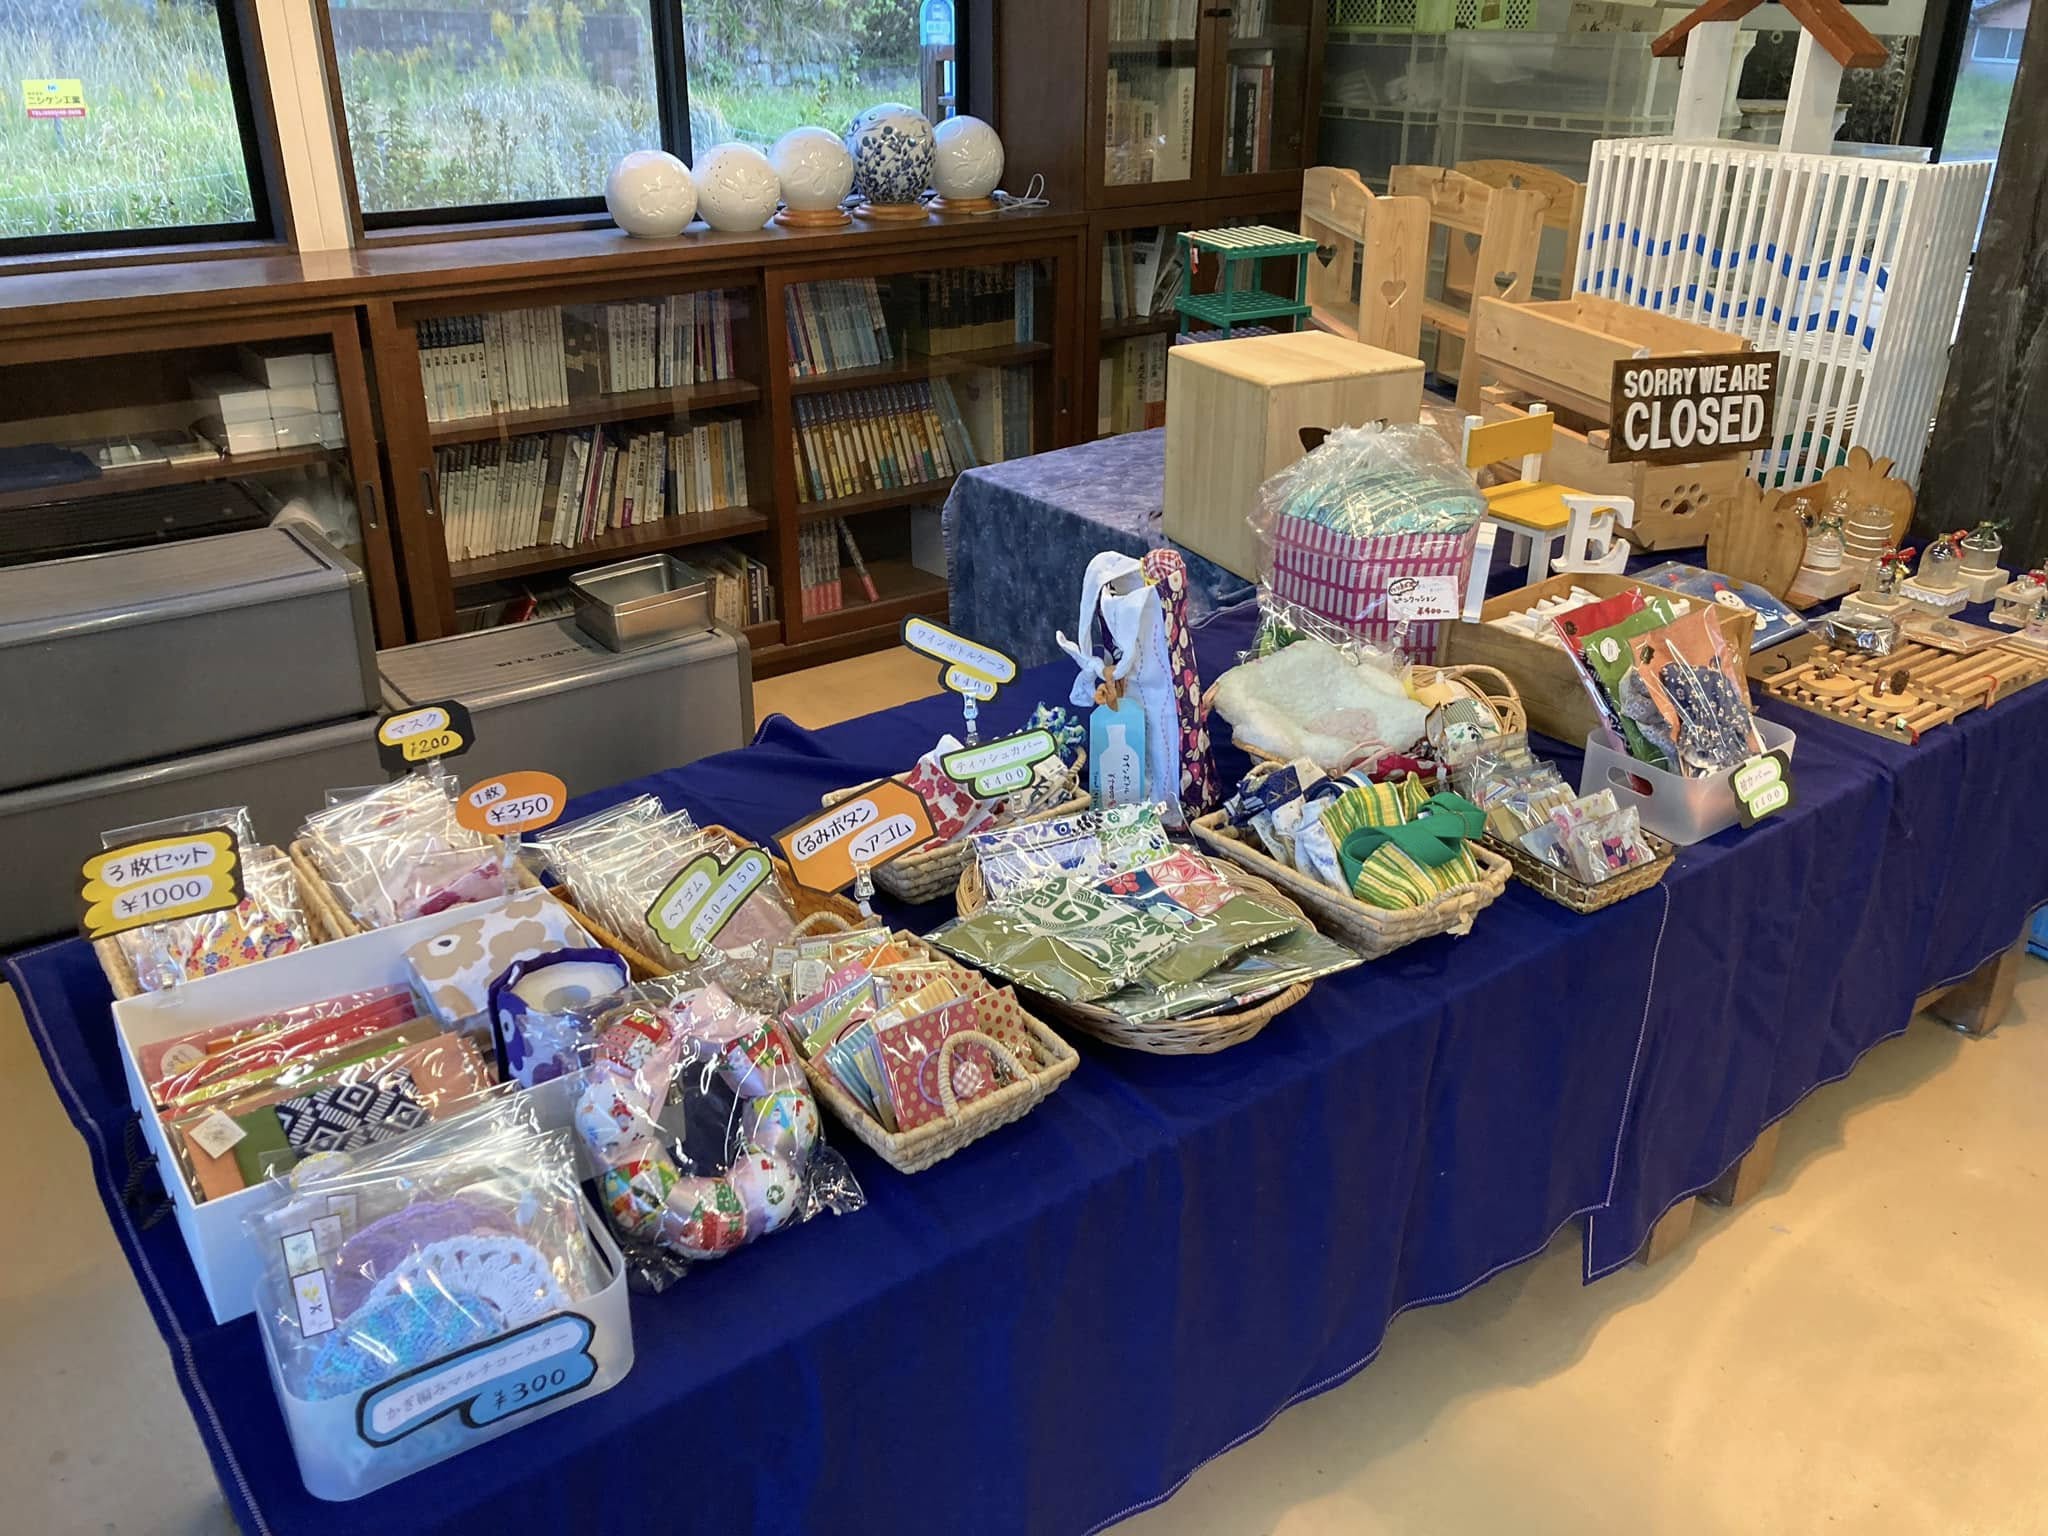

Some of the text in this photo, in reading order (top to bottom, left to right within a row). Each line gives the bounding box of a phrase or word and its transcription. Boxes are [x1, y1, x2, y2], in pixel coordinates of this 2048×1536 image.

[1624, 362, 1772, 399] SORRY WE ARE
[1624, 394, 1765, 451] CLOSED
[1551, 494, 1634, 574] E
[917, 629, 1006, 673] ワインボトルケース
[953, 671, 992, 694] ¥400
[391, 713, 438, 736] マスク
[410, 734, 450, 757] ¥200
[955, 740, 1043, 773] ティッシュカバー
[475, 785, 501, 806] 1枚
[983, 768, 1024, 789] ¥400
[490, 797, 549, 823] ¥350
[796, 807, 871, 857] くるみボタン
[855, 822, 912, 858] ヘアゴム
[108, 846, 208, 883] 3枚セット
[120, 880, 202, 914] ¥1000
[669, 880, 704, 922] ヘアゴム
[384, 1333, 570, 1421] かぎ編みマルチコースター
[493, 1367, 567, 1411] ¥300
